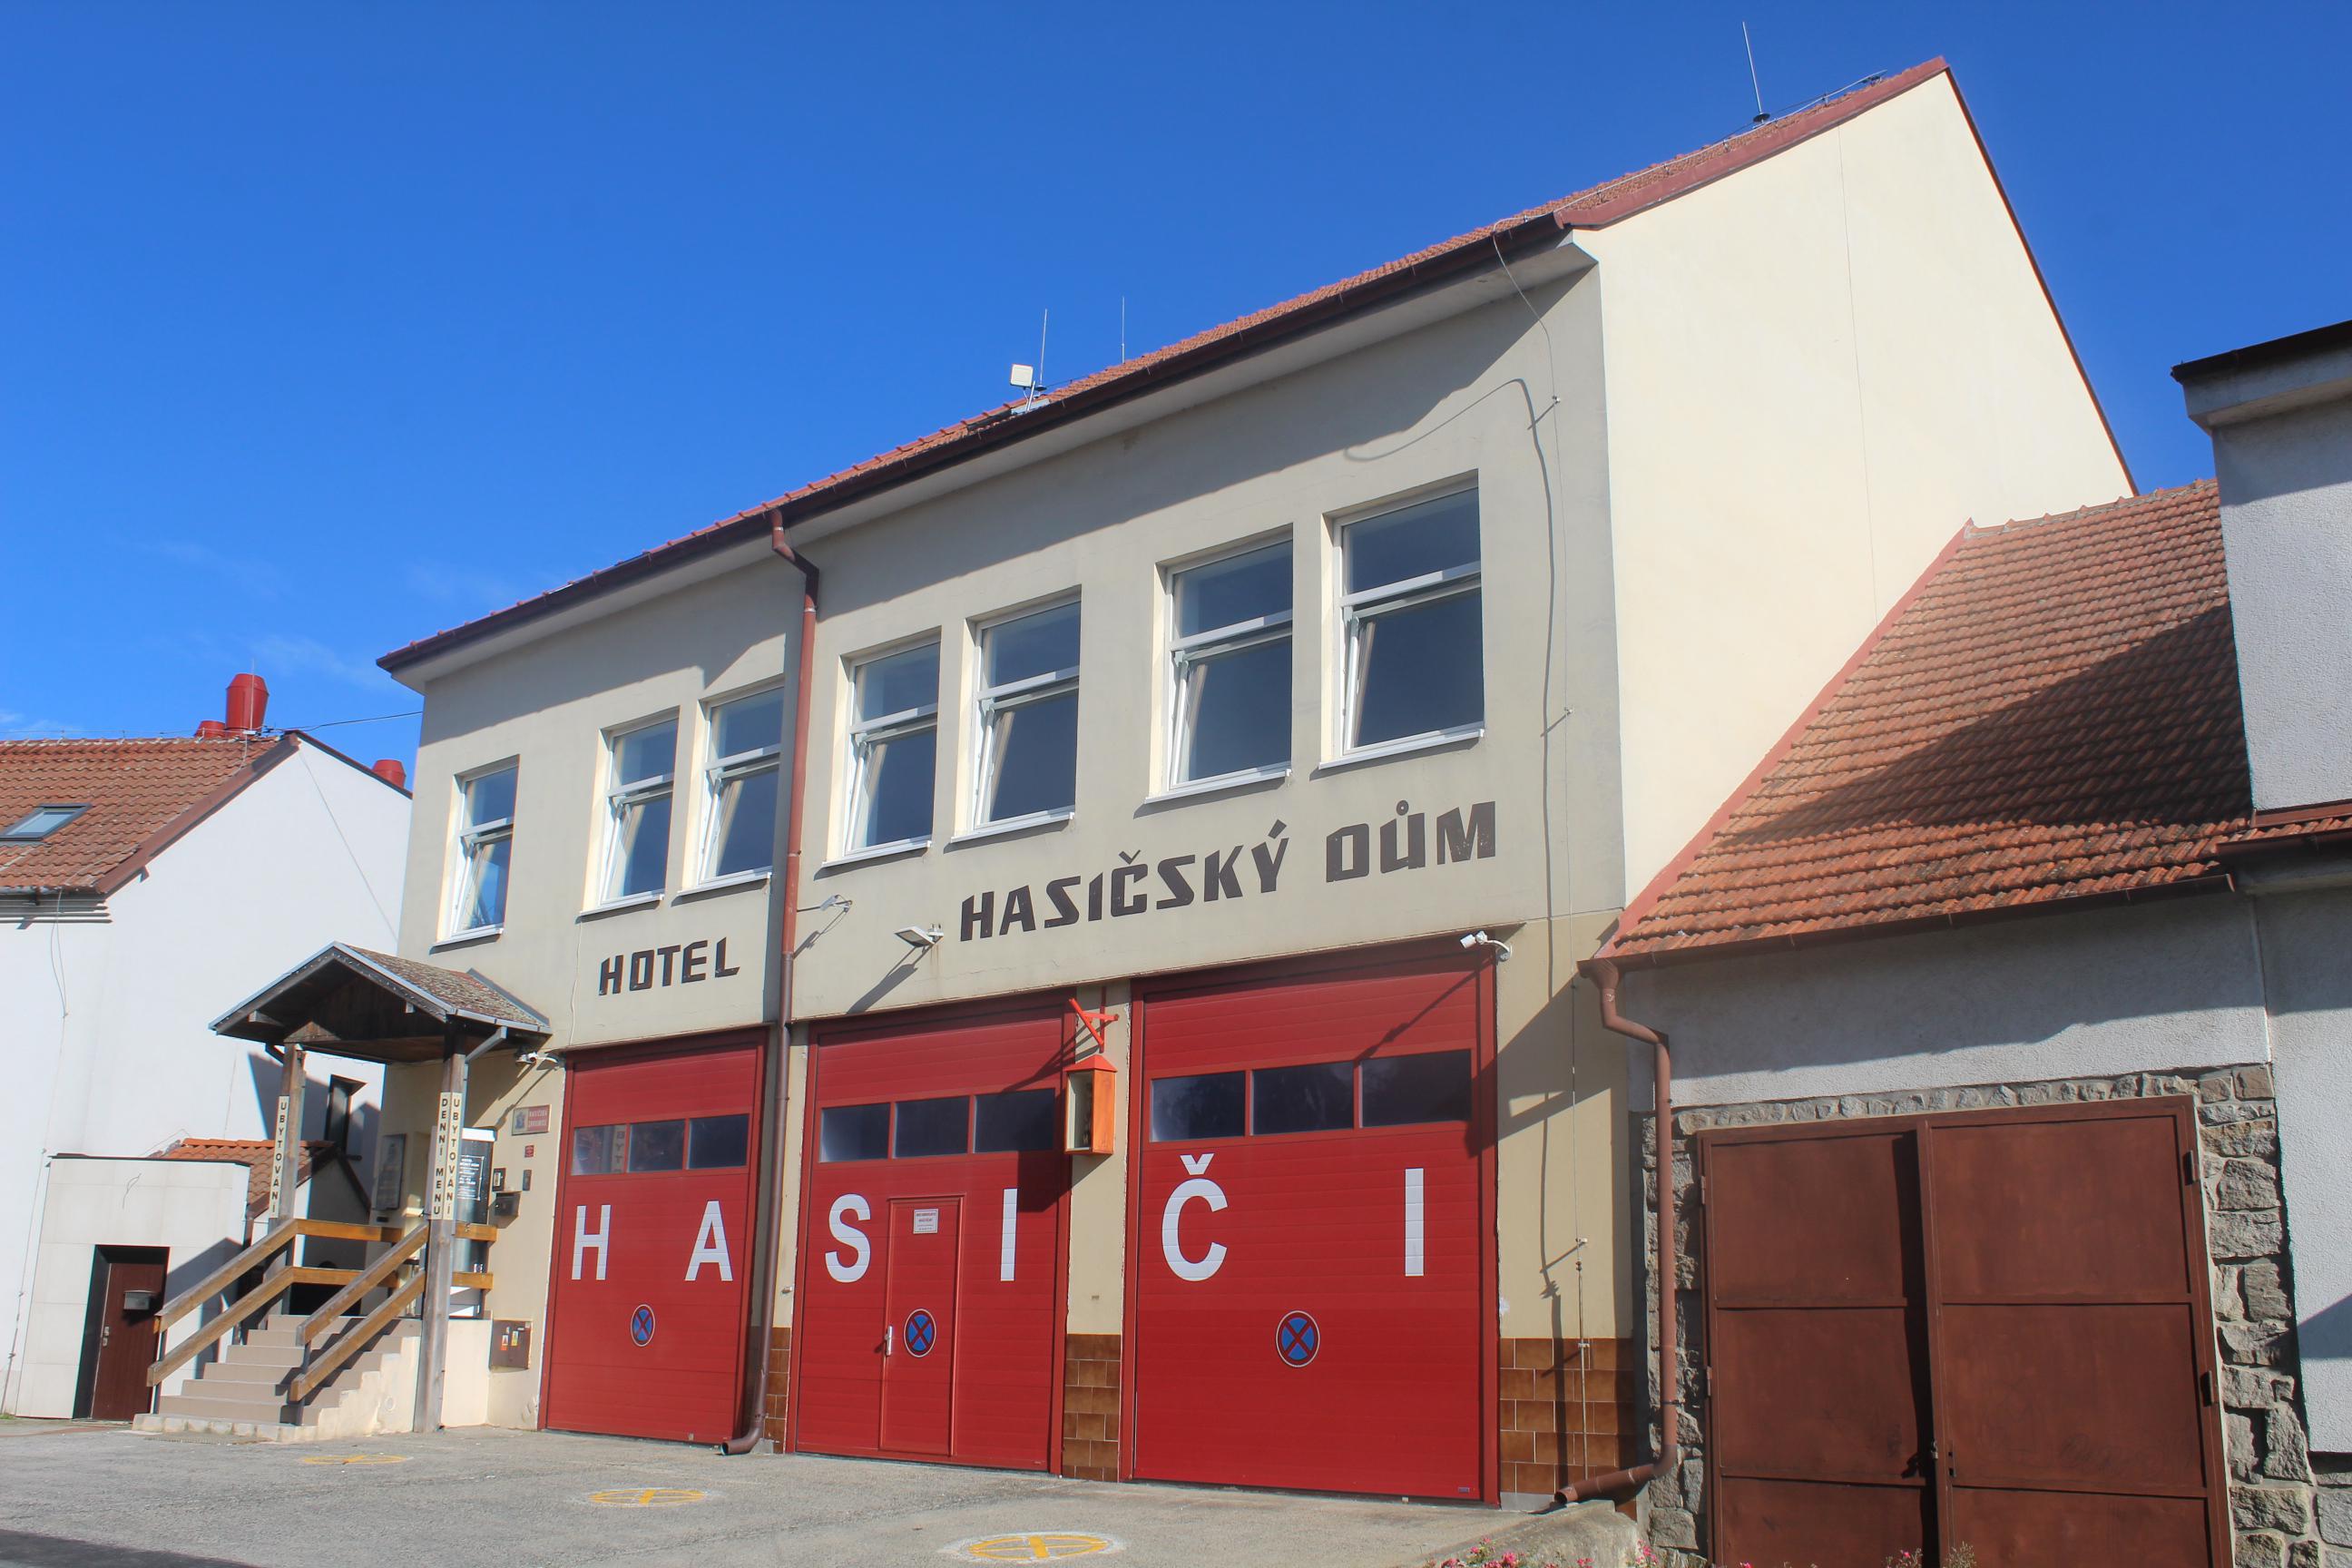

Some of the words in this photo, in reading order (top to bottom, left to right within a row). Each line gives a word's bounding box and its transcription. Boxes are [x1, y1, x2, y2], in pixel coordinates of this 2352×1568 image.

[598, 936, 740, 995] HOTEL
[960, 819, 1289, 941] HASIČSKÝ
[1326, 799, 1496, 883] DŮM
[438, 1098, 449, 1156] DENNÍ
[434, 1168, 444, 1215] MENU
